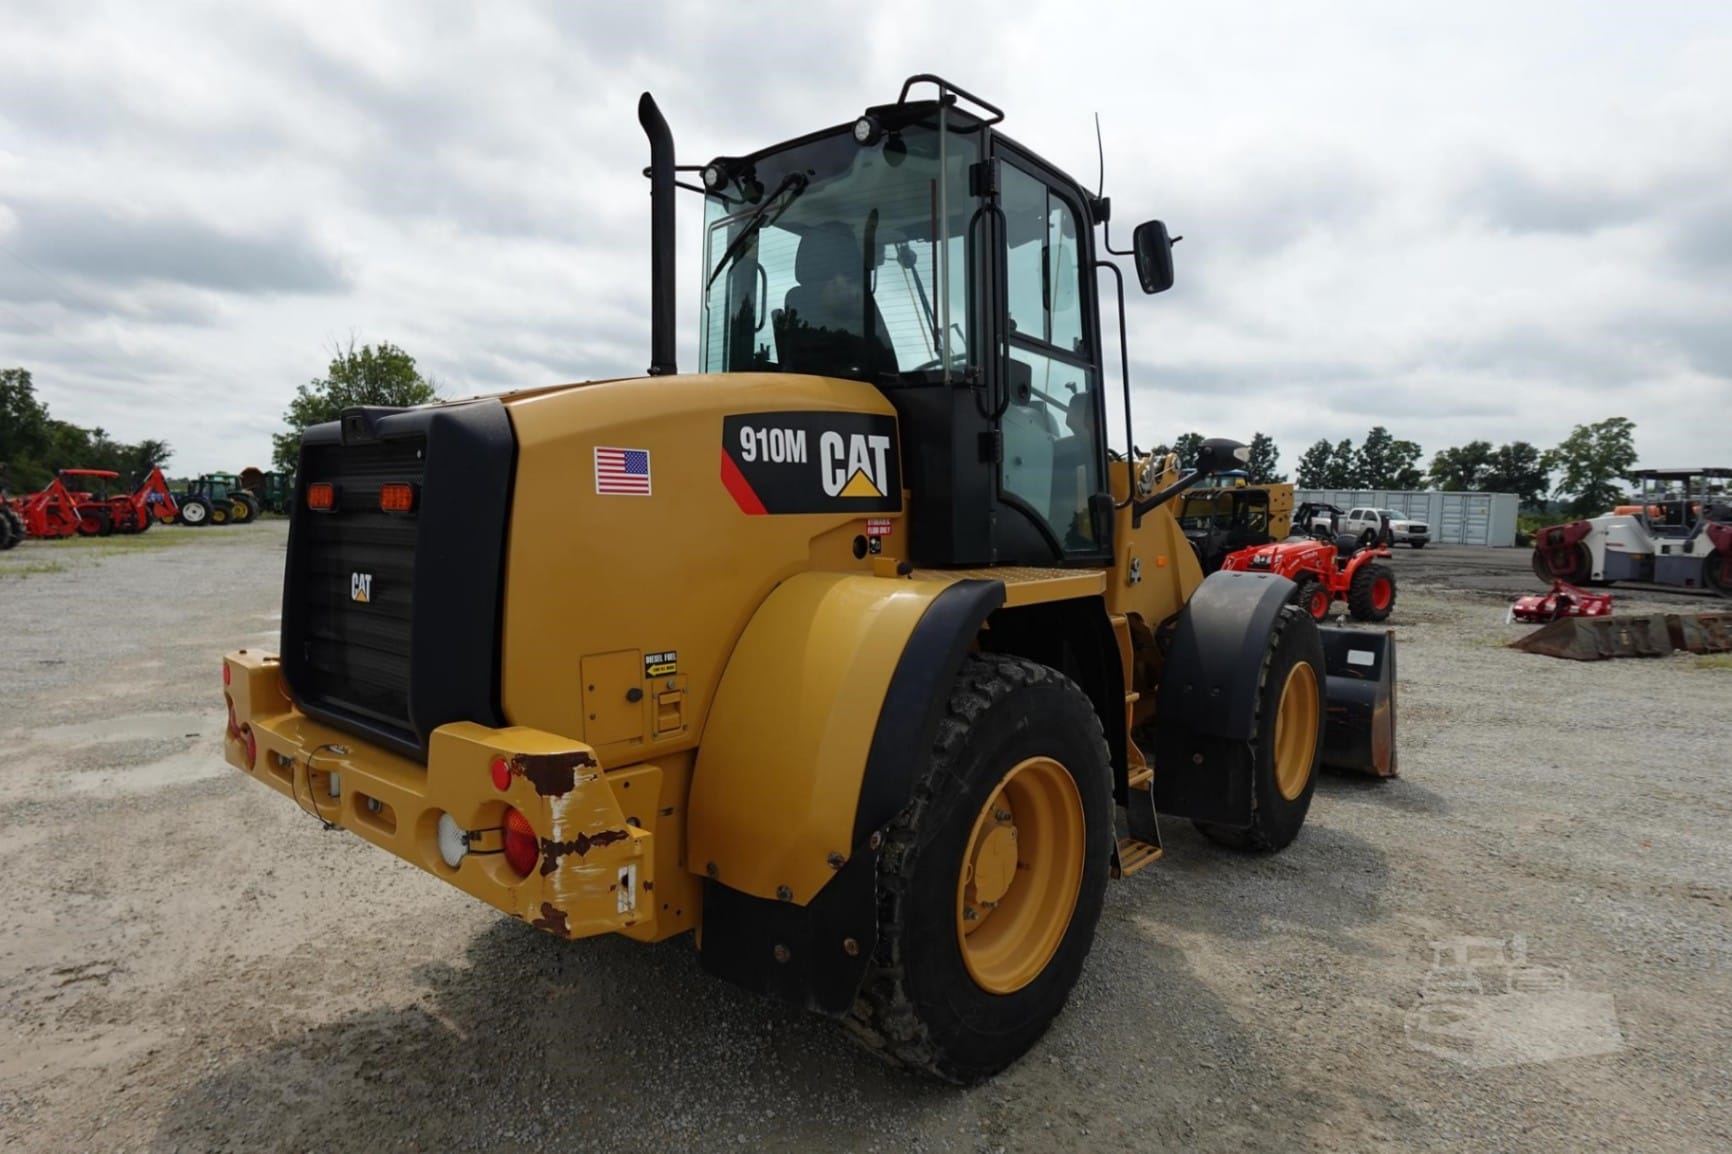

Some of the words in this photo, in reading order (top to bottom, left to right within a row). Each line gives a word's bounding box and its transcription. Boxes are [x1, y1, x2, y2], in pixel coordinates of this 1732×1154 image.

[740, 426, 807, 463] 910M
[820, 431, 890, 496] CAT
[351, 572, 372, 602] CAT
